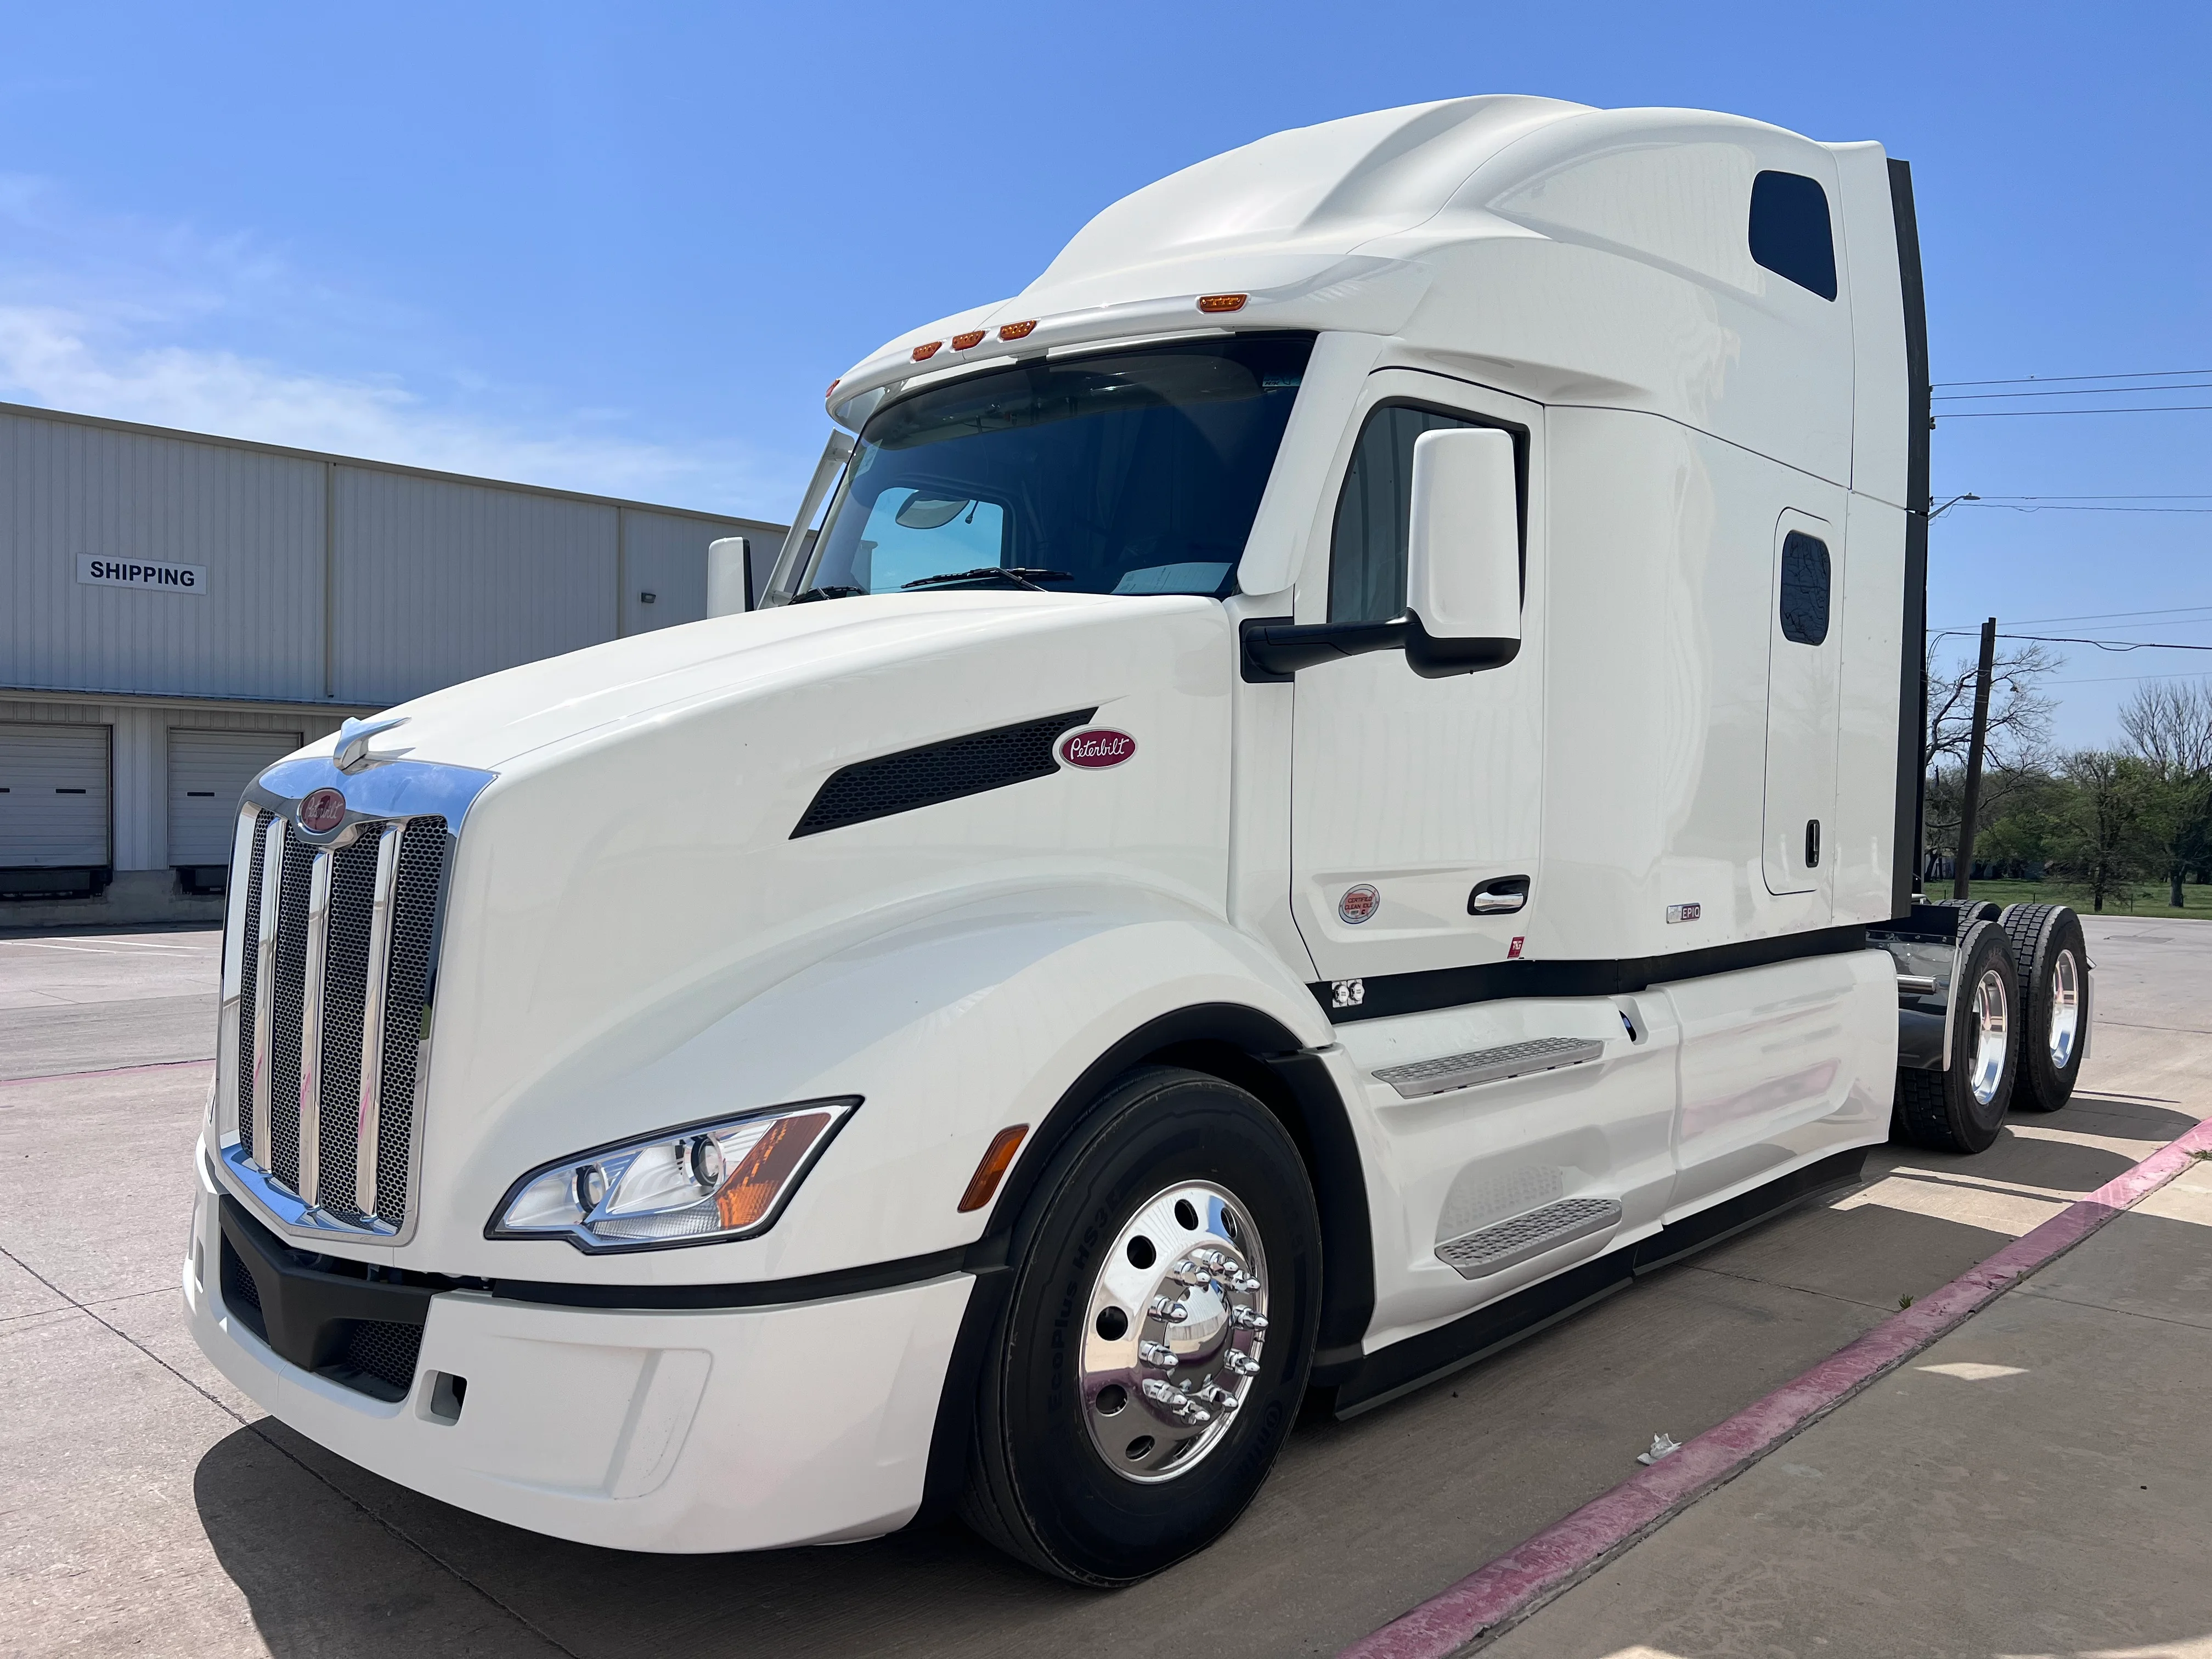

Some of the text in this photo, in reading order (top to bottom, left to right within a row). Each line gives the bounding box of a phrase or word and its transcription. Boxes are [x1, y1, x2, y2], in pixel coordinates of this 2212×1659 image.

[91, 561, 195, 586] SHIPPING
[1070, 738, 1130, 760] Peterbilt
[304, 797, 343, 820] Peterbilt
[1683, 906, 1700, 919] EPIQ
